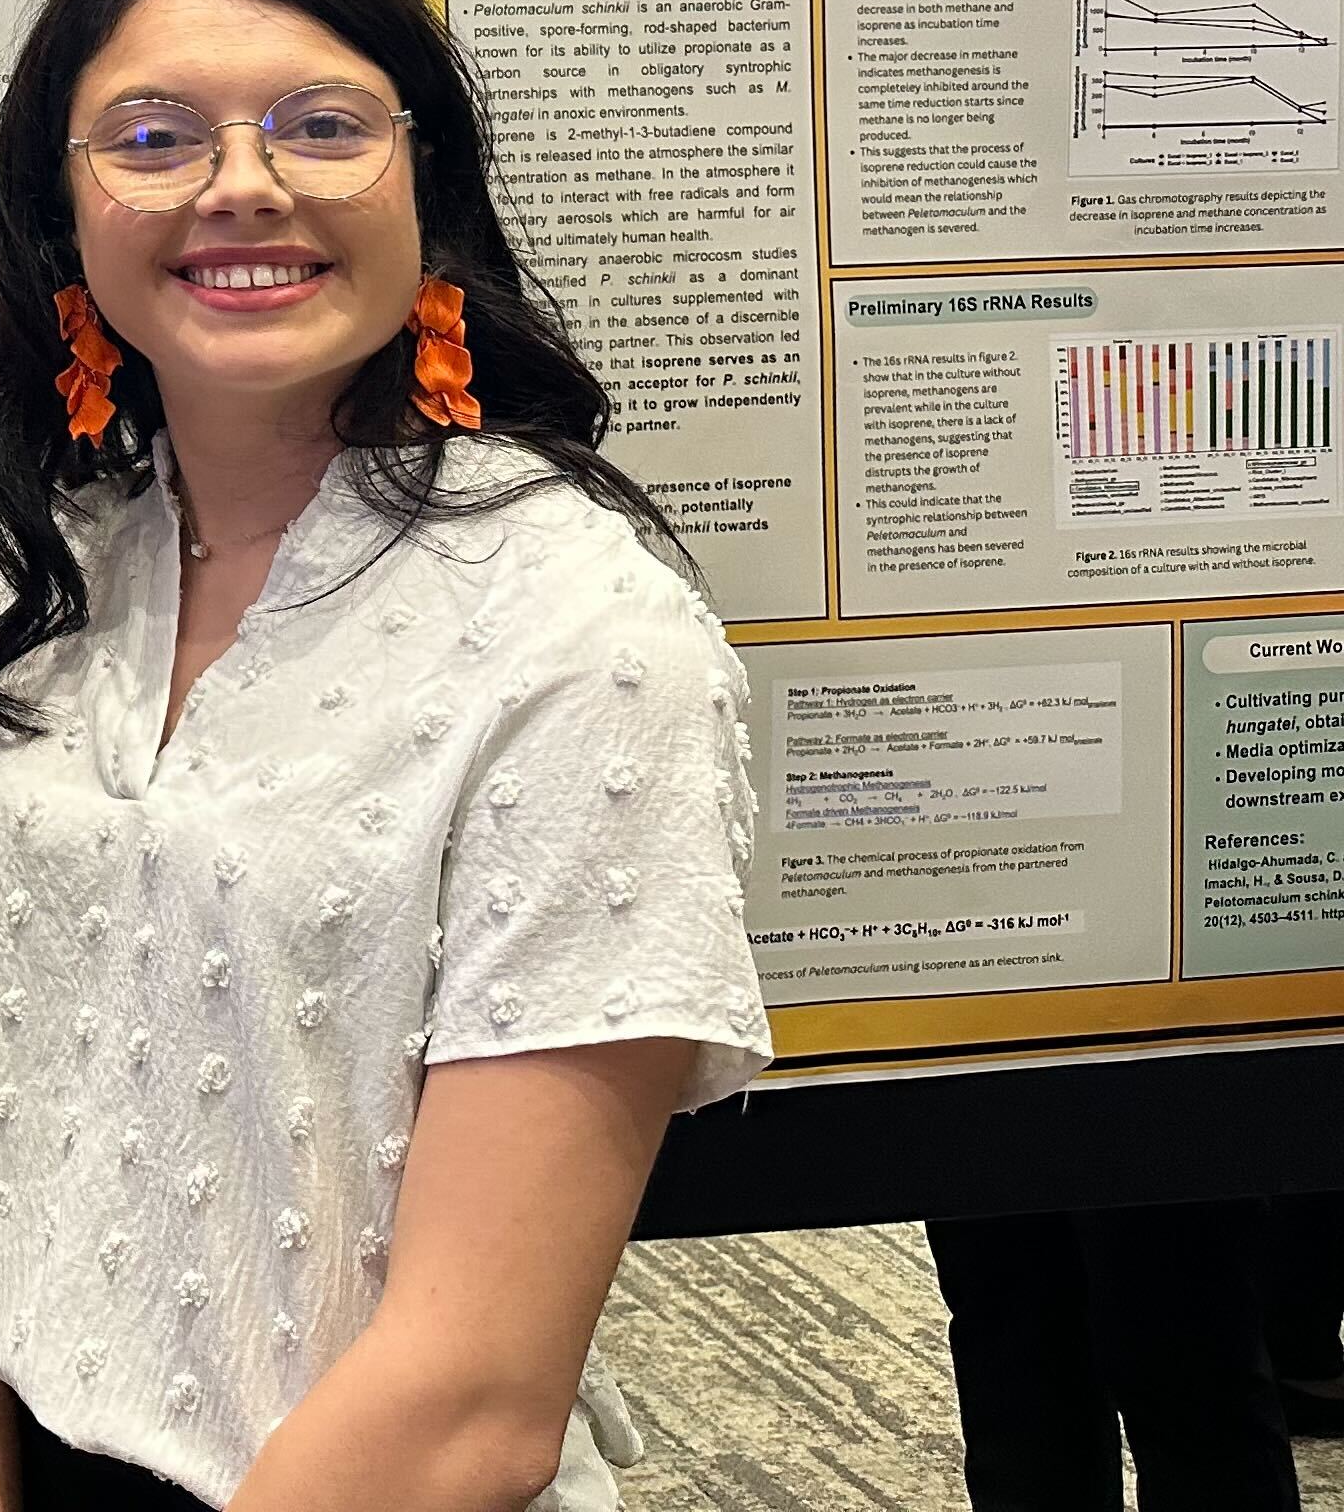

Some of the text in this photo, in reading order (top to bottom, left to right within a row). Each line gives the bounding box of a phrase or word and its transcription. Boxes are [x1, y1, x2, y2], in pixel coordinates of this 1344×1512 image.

[473, 2, 574, 17] Pelotomaculum
[581, 1, 631, 15] schinkii
[637, 3, 648, 14] is
[655, 2, 672, 13] an
[848, 292, 1093, 317] Preliminary 16S rRNA Results
[1249, 640, 1313, 659] Current
[1205, 833, 1305, 850] References:
